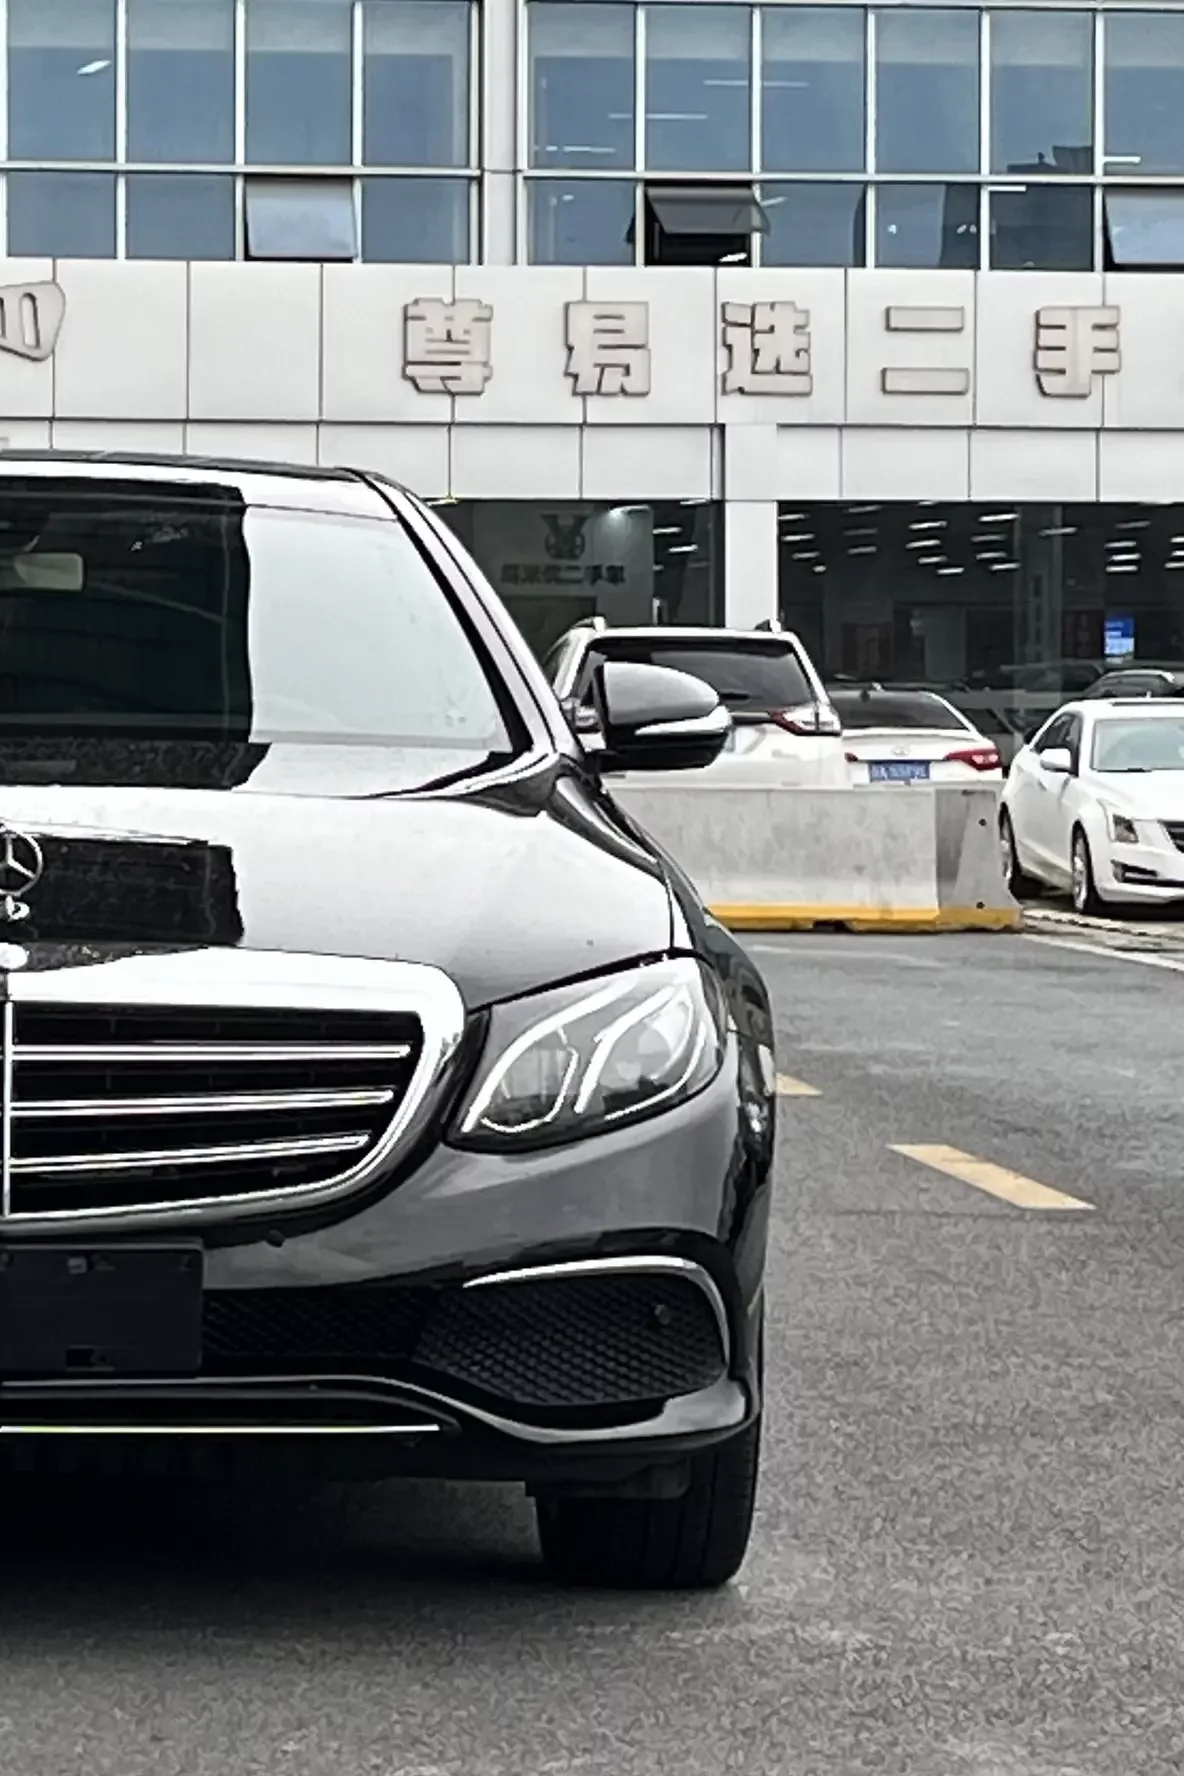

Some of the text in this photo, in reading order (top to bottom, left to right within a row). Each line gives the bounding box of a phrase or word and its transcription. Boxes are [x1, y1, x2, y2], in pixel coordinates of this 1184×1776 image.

[403, 298, 1122, 398] 尊易选二手
